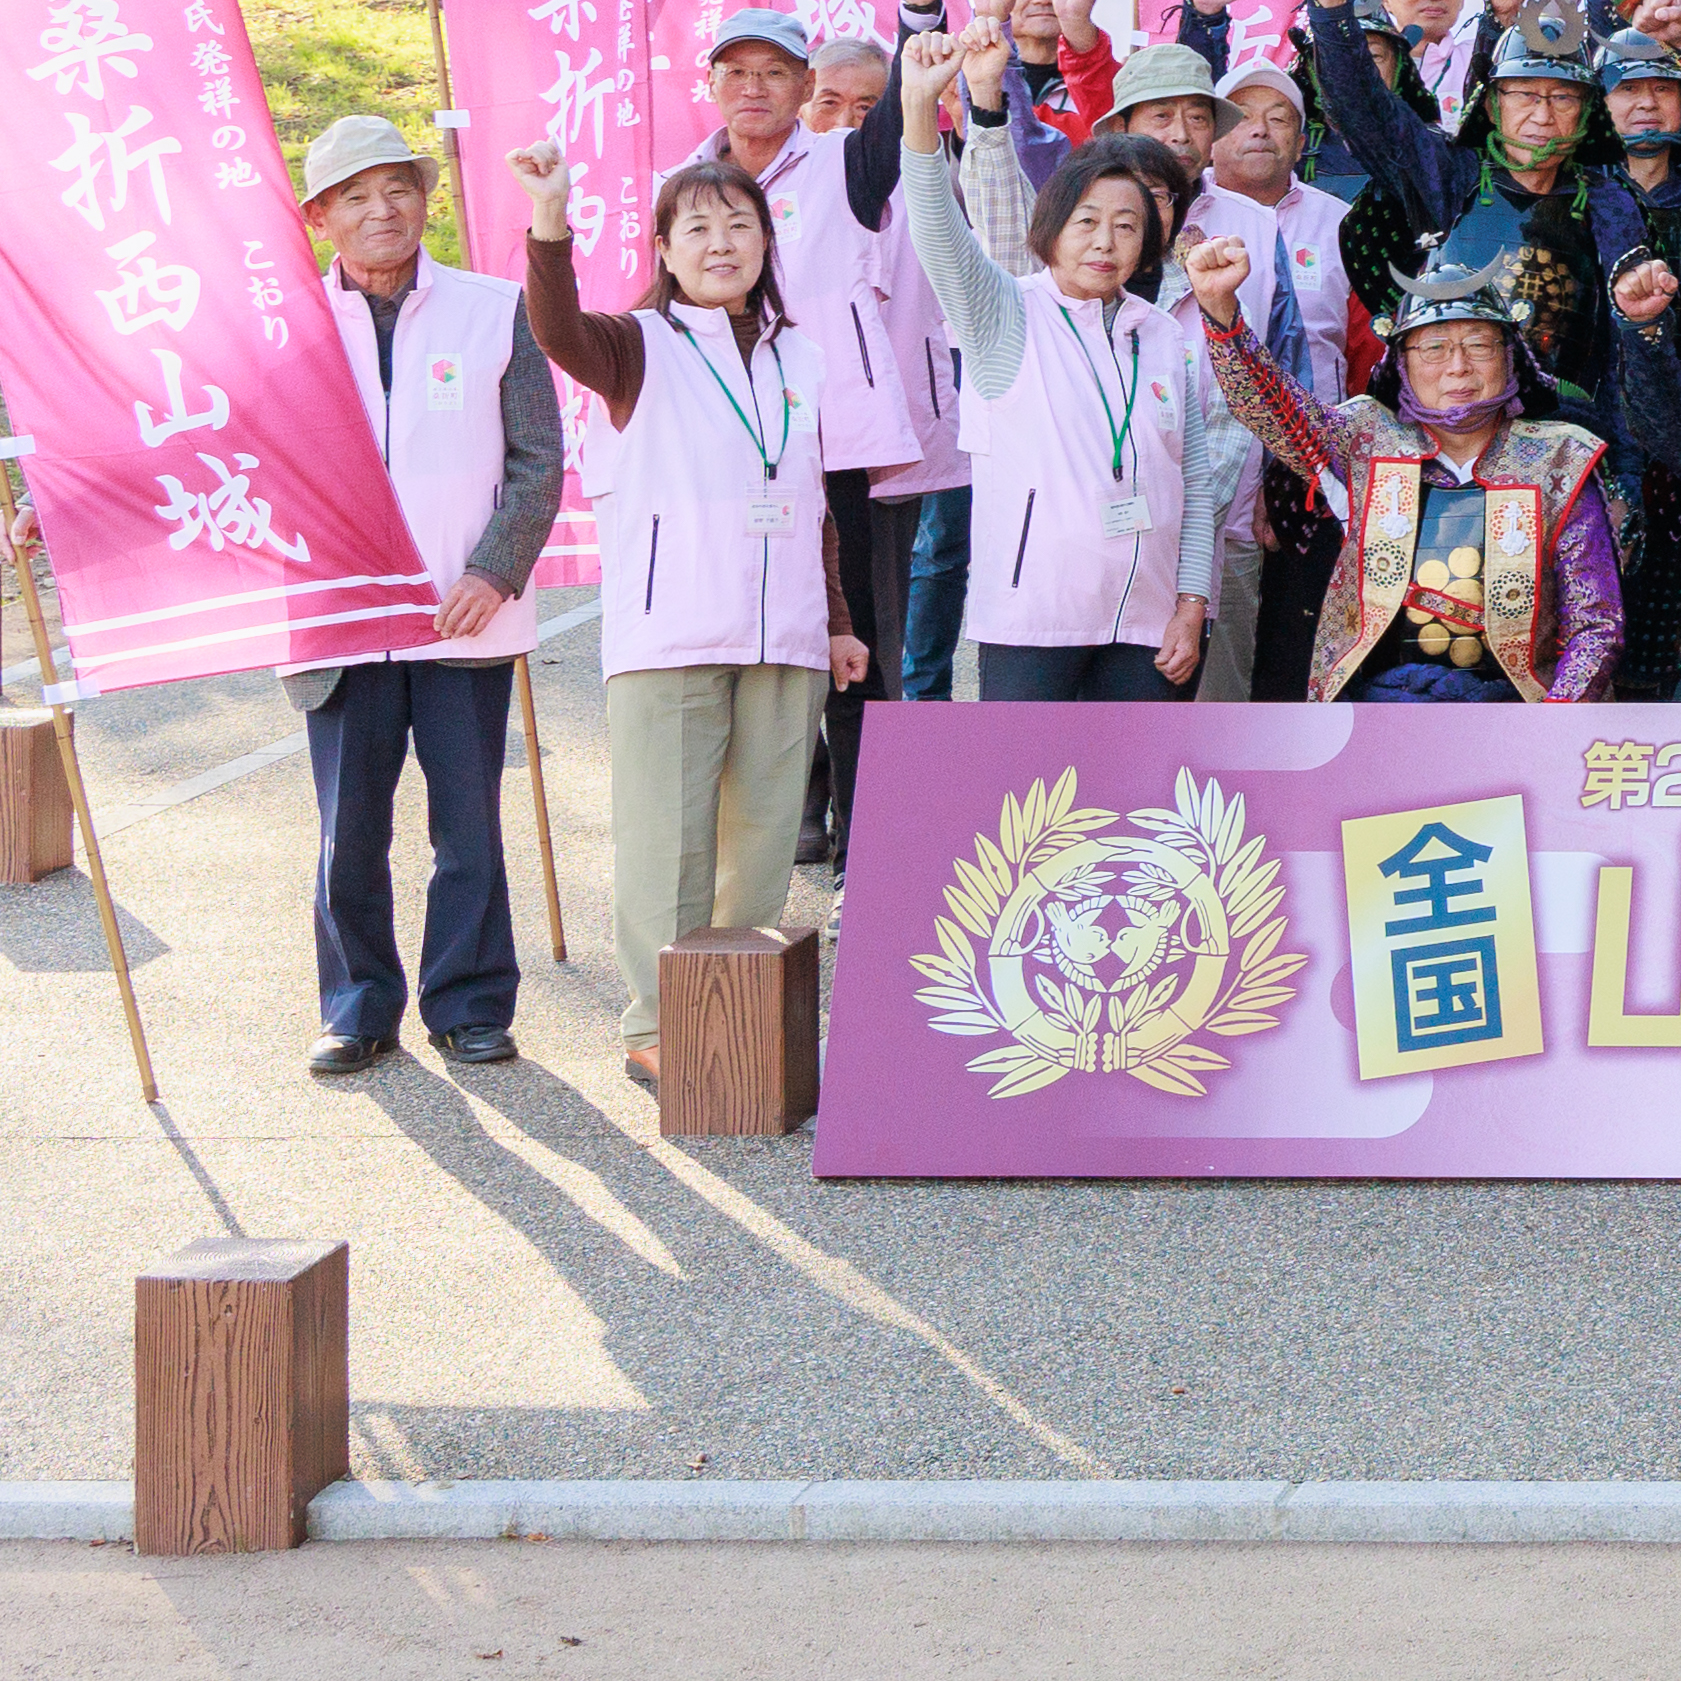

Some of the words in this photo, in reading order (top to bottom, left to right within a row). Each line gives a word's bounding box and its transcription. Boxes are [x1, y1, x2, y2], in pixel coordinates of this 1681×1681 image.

[618, 176, 642, 279] こおり
[244, 240, 290, 349] こおり
[1377, 821, 1503, 1053] 全国
